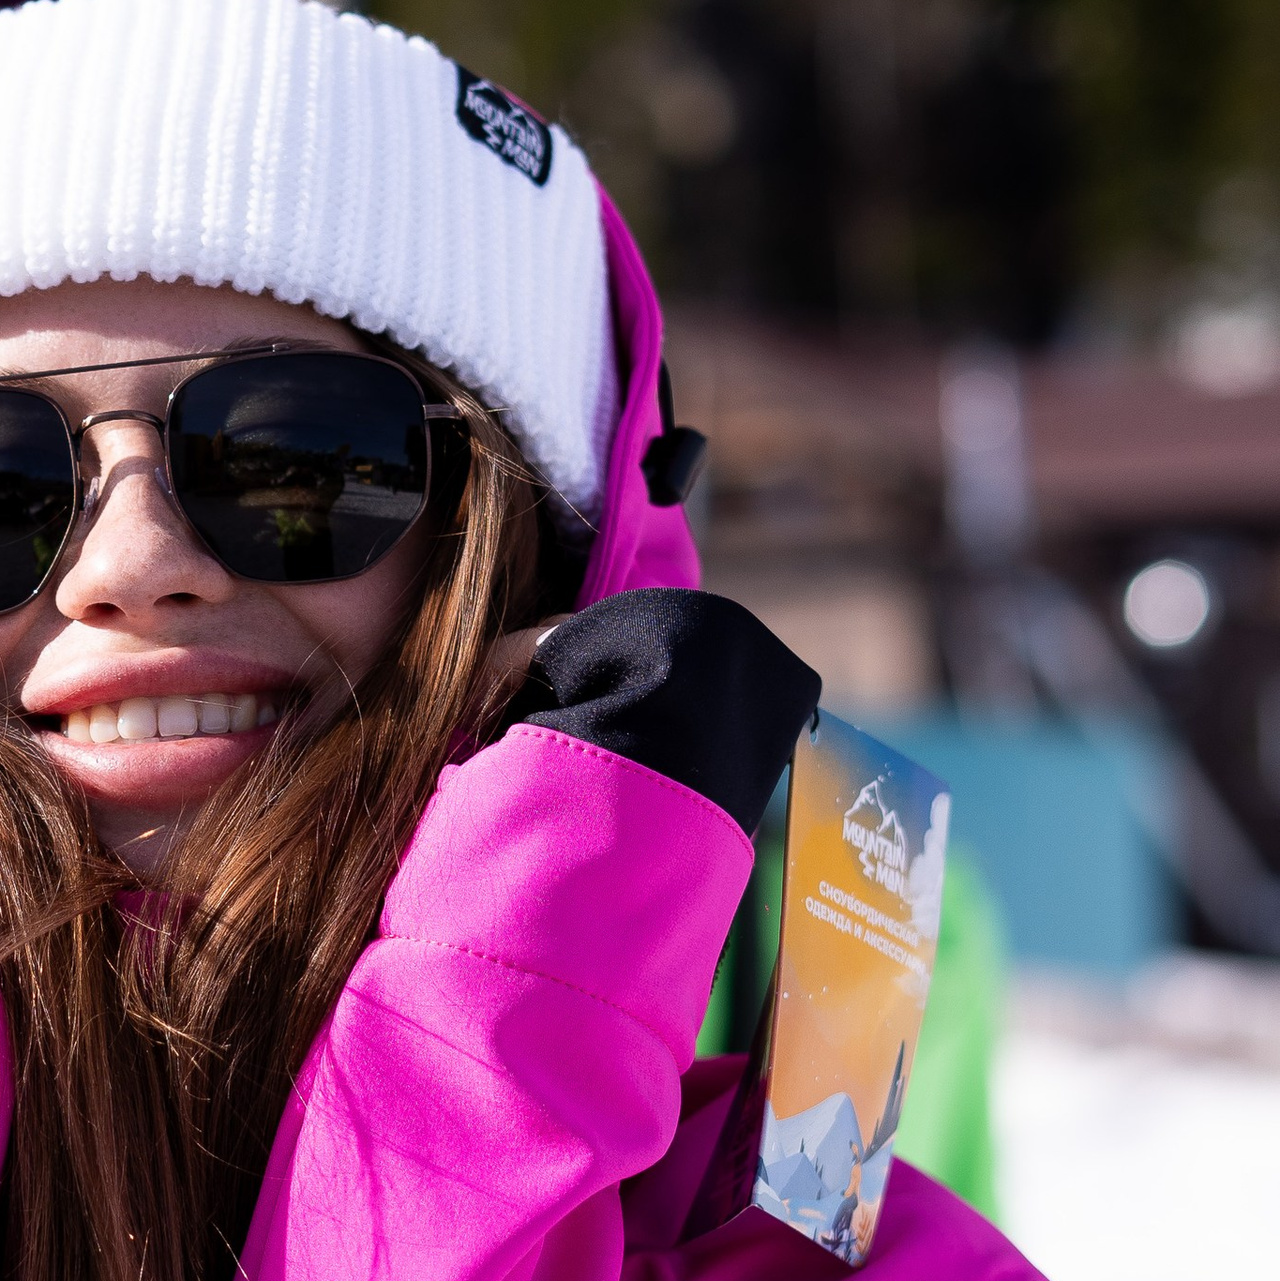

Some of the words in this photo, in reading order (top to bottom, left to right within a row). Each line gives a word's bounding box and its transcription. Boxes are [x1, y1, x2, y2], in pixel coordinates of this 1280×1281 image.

[464, 91, 544, 160] MOUNTAIN
[842, 818, 906, 874] MOUNTAIN
[876, 860, 904, 898] MAN
[805, 896, 852, 934] ОДЕЖДА
[853, 922, 863, 939] И
